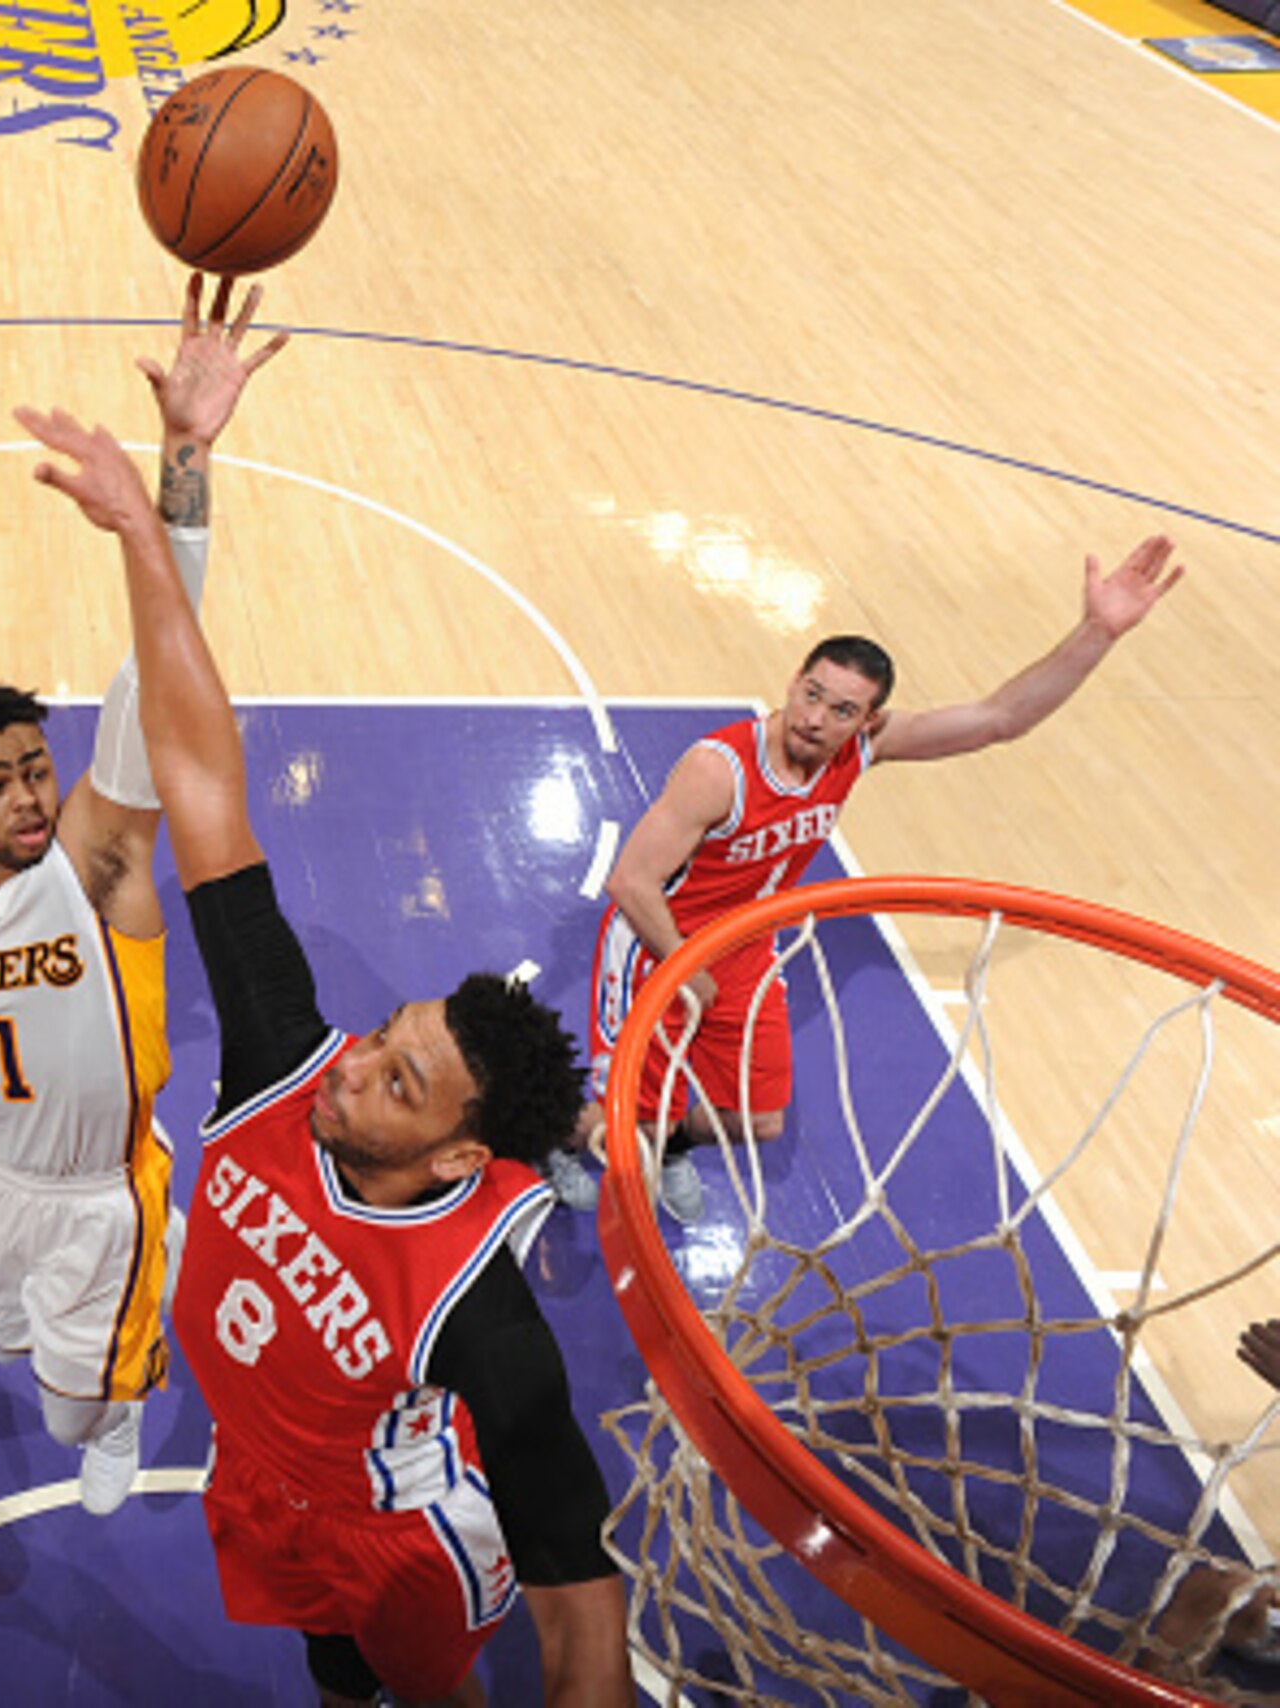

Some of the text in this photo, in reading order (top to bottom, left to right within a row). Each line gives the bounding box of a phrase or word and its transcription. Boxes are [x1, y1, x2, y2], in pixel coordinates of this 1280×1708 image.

[120, 3, 187, 118] ANGEL
[724, 803, 839, 863] SIXER
[756, 857, 789, 900] 1
[205, 1154, 394, 1380] SIXERS
[215, 1277, 278, 1367] 8
